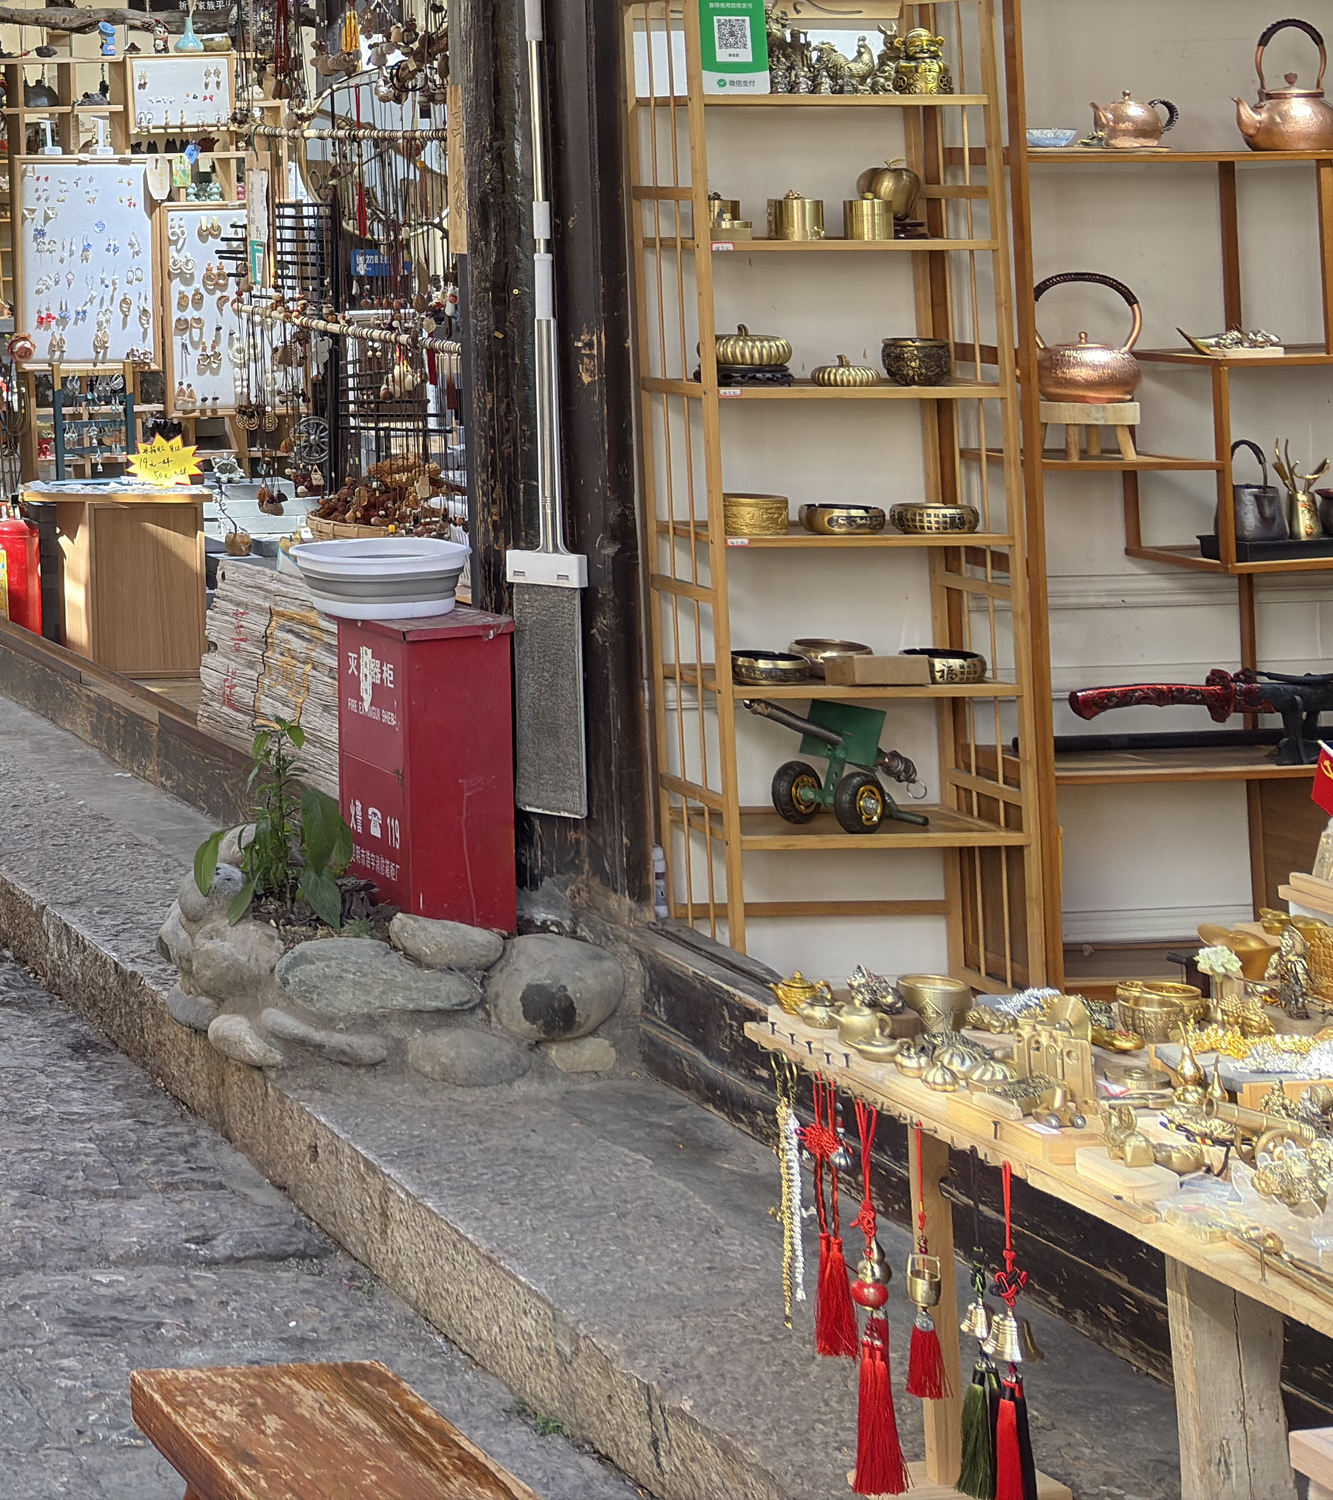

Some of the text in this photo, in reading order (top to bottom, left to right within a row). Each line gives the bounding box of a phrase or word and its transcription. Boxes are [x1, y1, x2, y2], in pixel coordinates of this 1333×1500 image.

[347, 652, 395, 688] 灭器柜
[386, 816, 400, 850] 119
